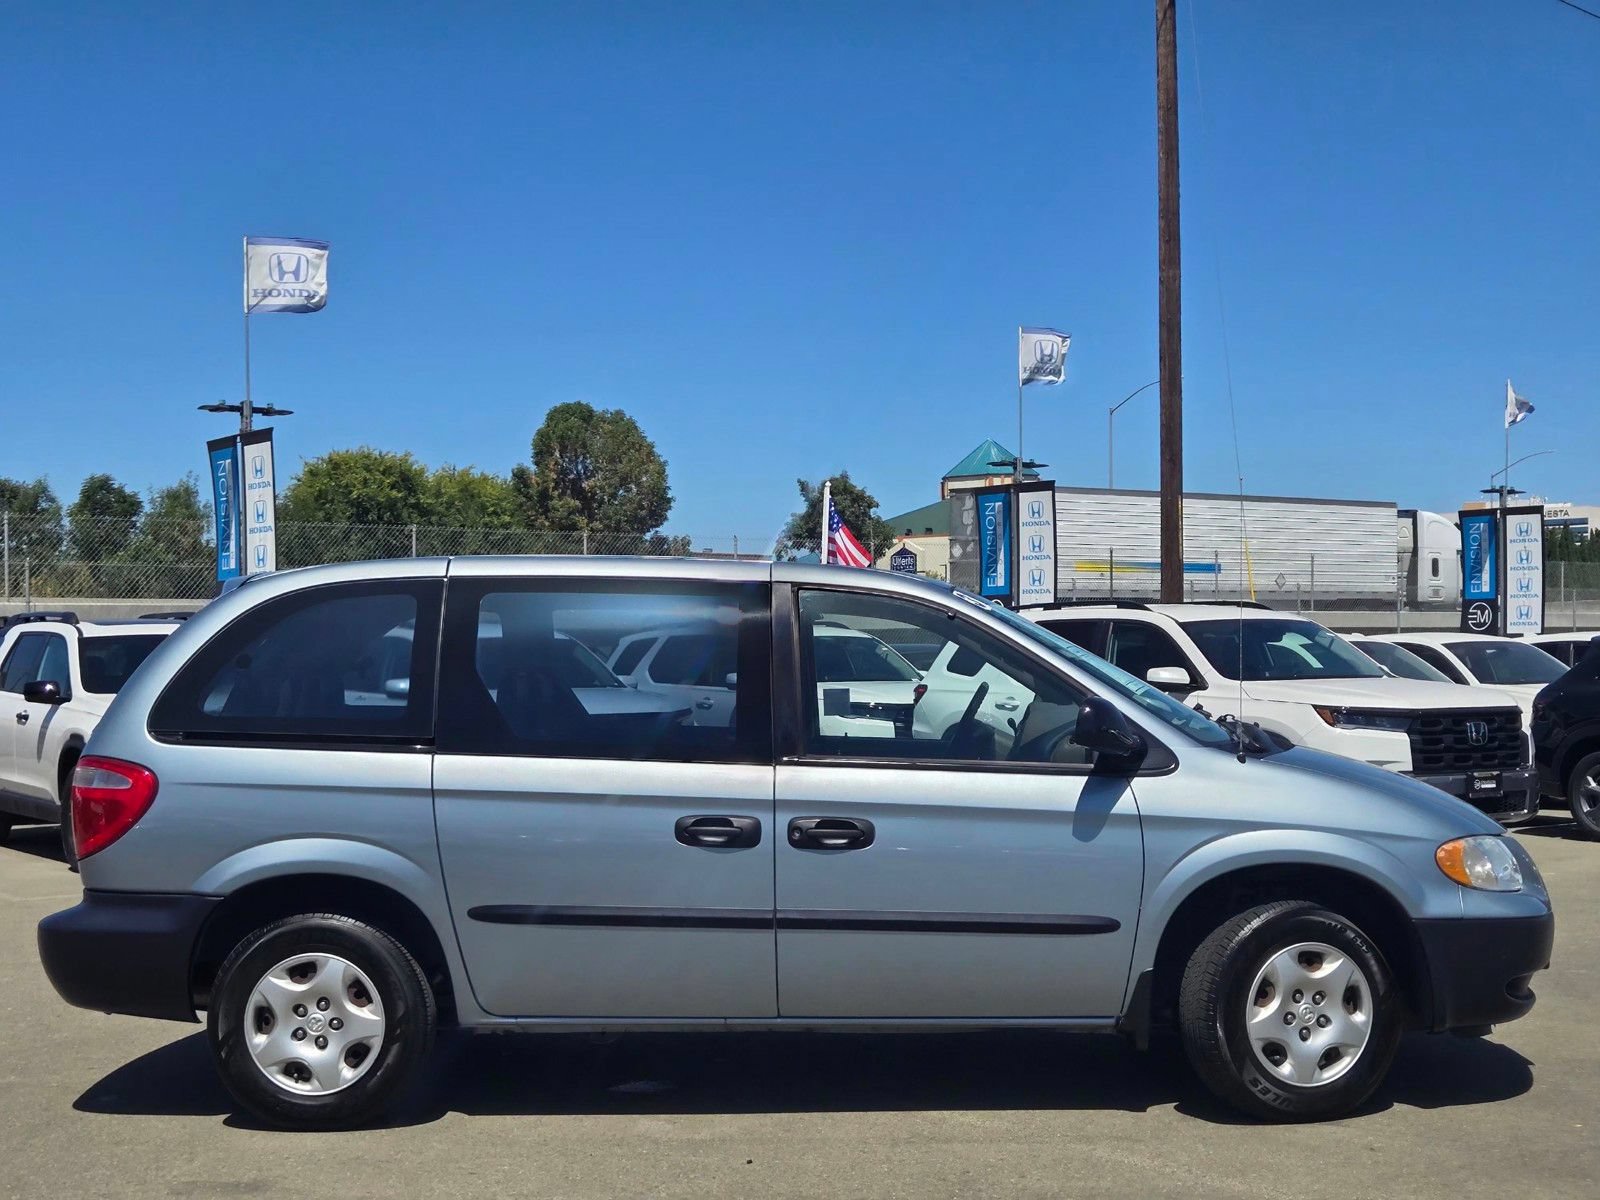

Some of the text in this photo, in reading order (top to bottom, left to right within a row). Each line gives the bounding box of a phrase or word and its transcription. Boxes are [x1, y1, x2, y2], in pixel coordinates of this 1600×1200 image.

[217, 460, 230, 570] ENVISION
[248, 481, 271, 491] HONDA
[248, 525, 273, 535] HONDA
[985, 502, 997, 587] ENVISION
[1469, 523, 1481, 593] ENVISION
